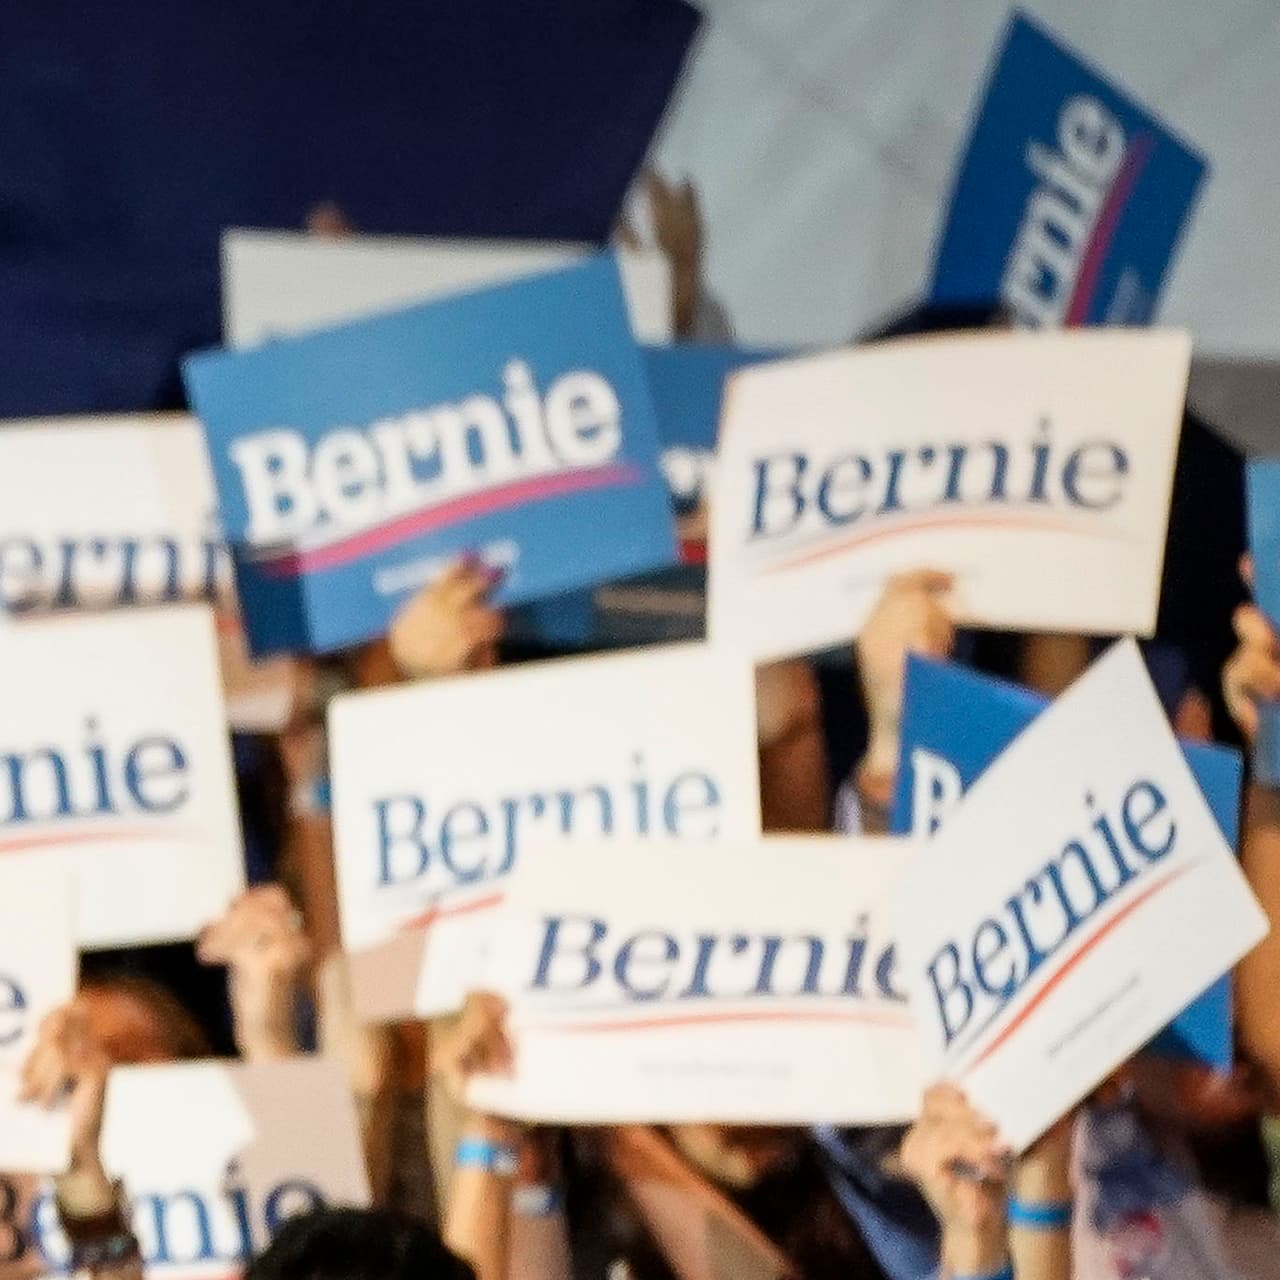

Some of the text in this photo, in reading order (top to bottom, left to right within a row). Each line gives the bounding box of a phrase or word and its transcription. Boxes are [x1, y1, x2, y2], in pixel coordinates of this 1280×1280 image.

[998, 95, 1128, 328] rnie
[230, 356, 624, 542] Bernie
[743, 416, 1130, 542] Bernie
[924, 776, 1178, 1048] Bernie
